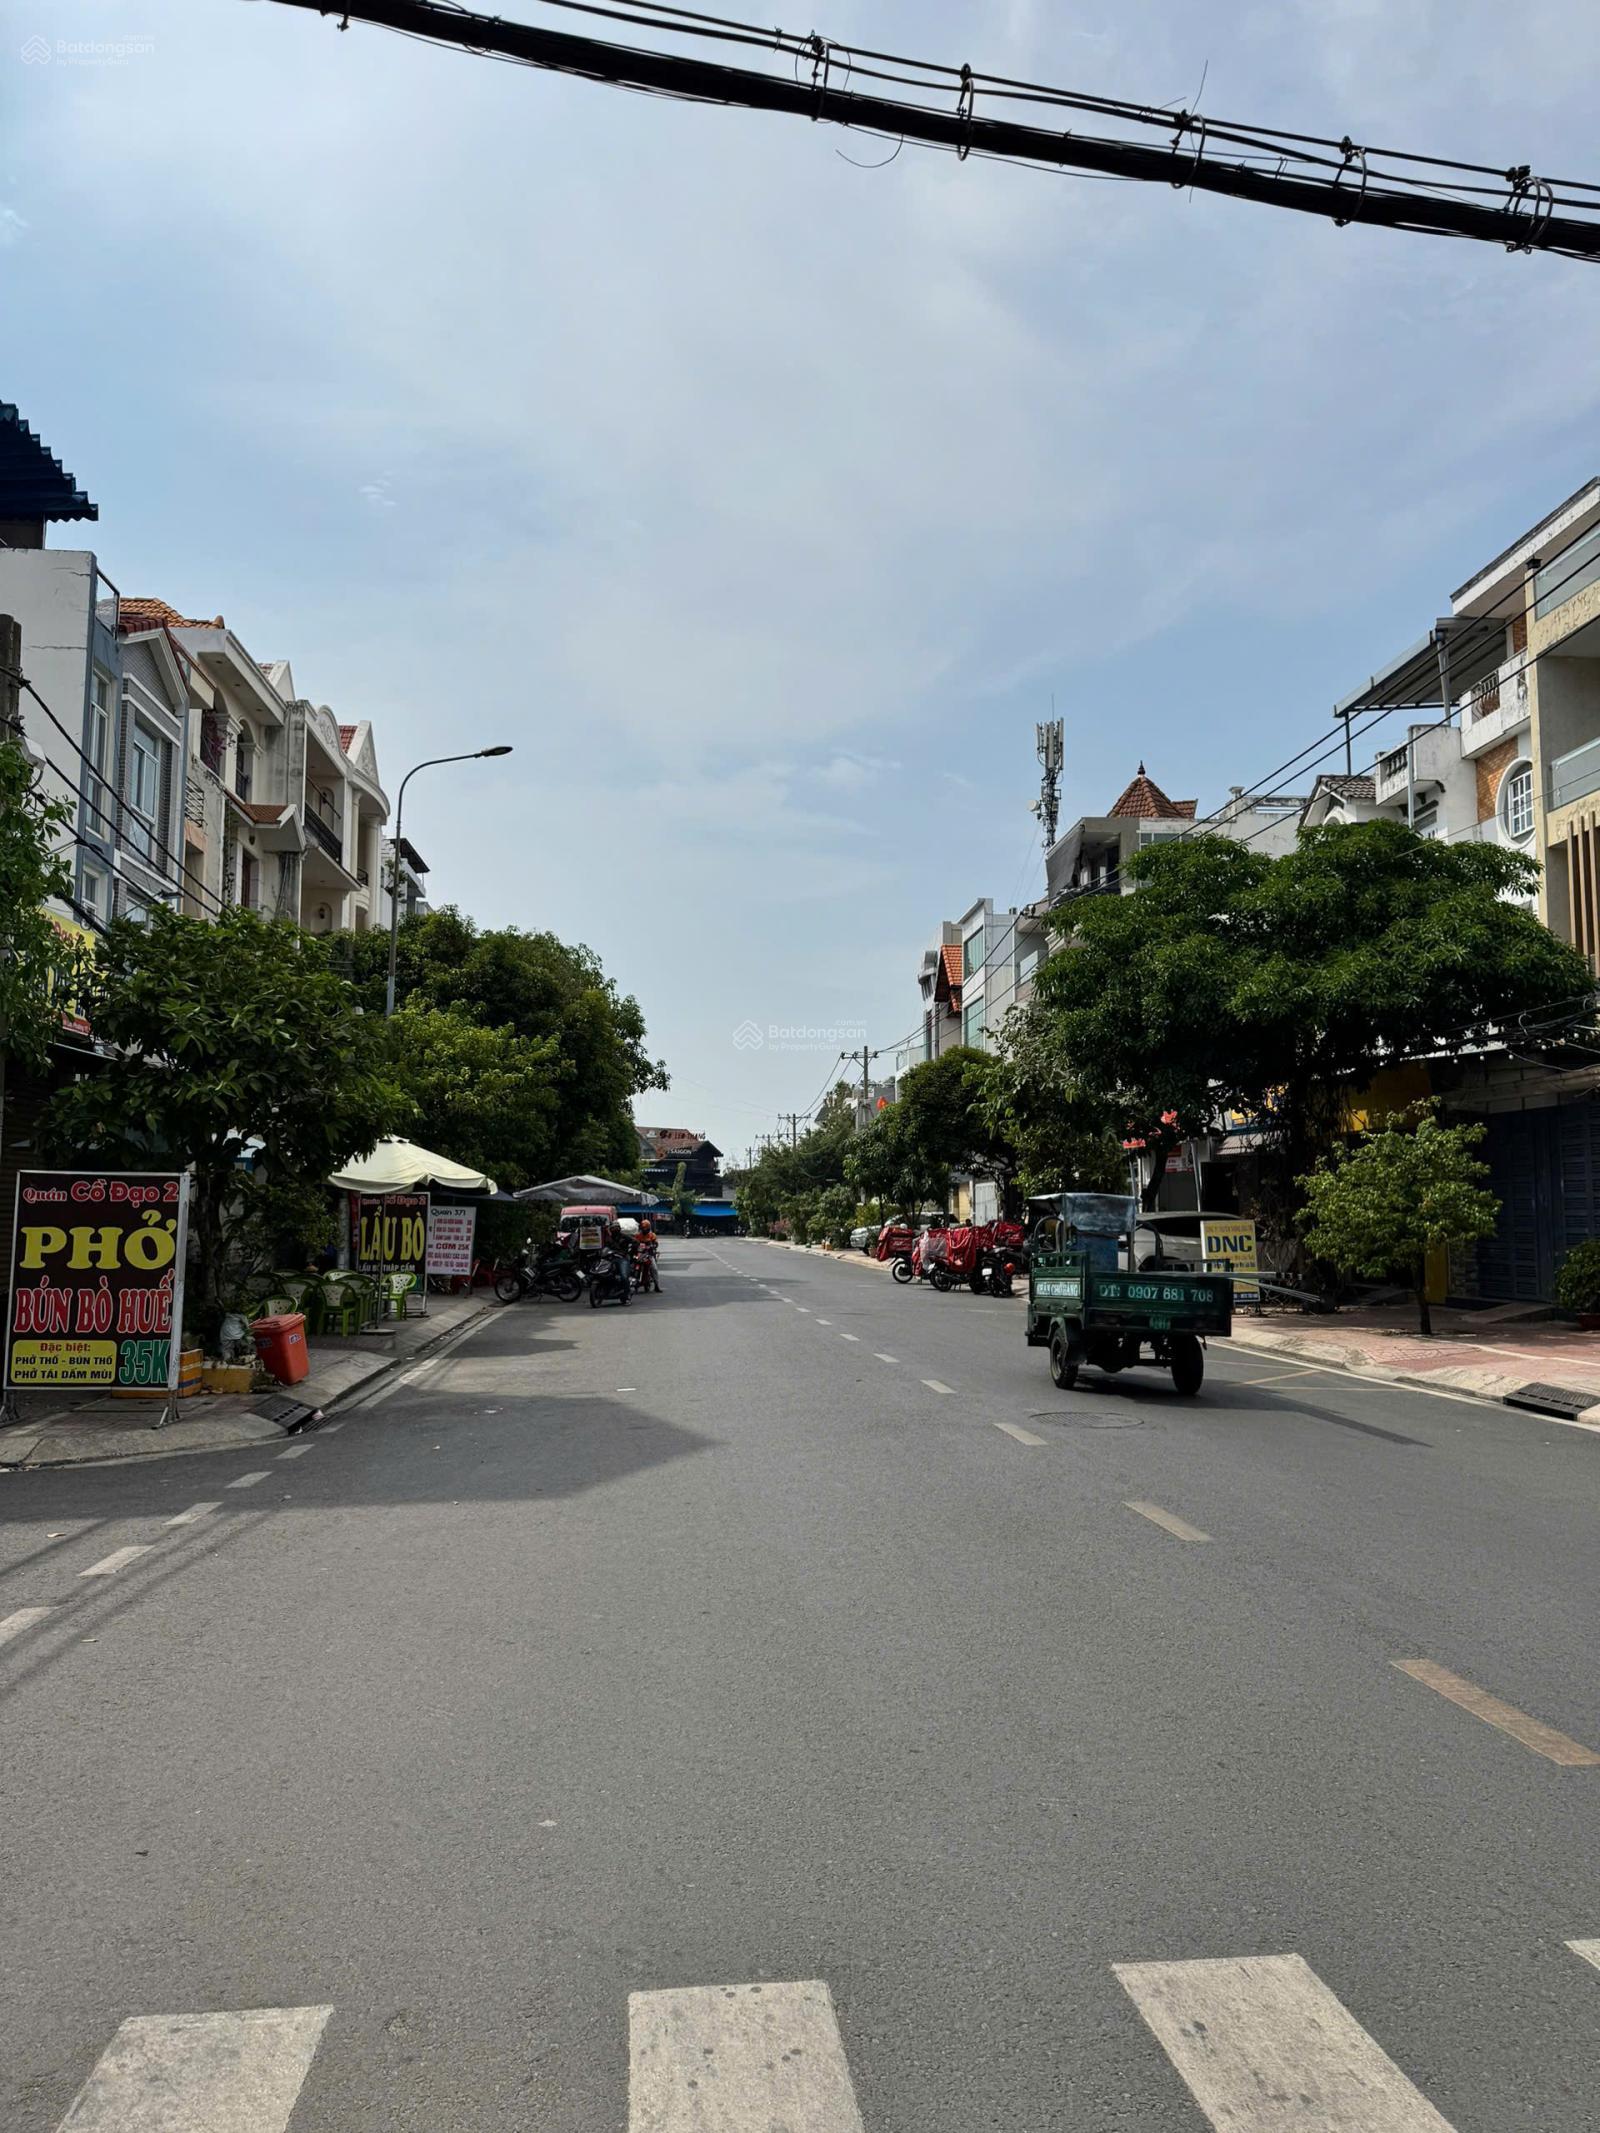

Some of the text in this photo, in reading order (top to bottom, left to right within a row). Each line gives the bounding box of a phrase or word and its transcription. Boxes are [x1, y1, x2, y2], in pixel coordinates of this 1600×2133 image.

[22, 1187, 67, 1204] Quán
[109, 1181, 160, 1208] Đạo
[162, 1181, 179, 1202] 2
[19, 1209, 177, 1270] PHỞ
[360, 1205, 397, 1261] LẨU
[400, 1211, 425, 1261] BÒ
[1207, 1234, 1252, 1253] DNC
[13, 1269, 175, 1333] BÚN BÒ HUẾ
[1128, 1286, 1158, 1300] 0907
[1190, 1288, 1214, 1302] 708
[15, 1354, 37, 1365] PHỞ
[40, 1343, 62, 1354] Đặc
[119, 1339, 171, 1384] 35K
[14, 1368, 38, 1379] PHỞ
